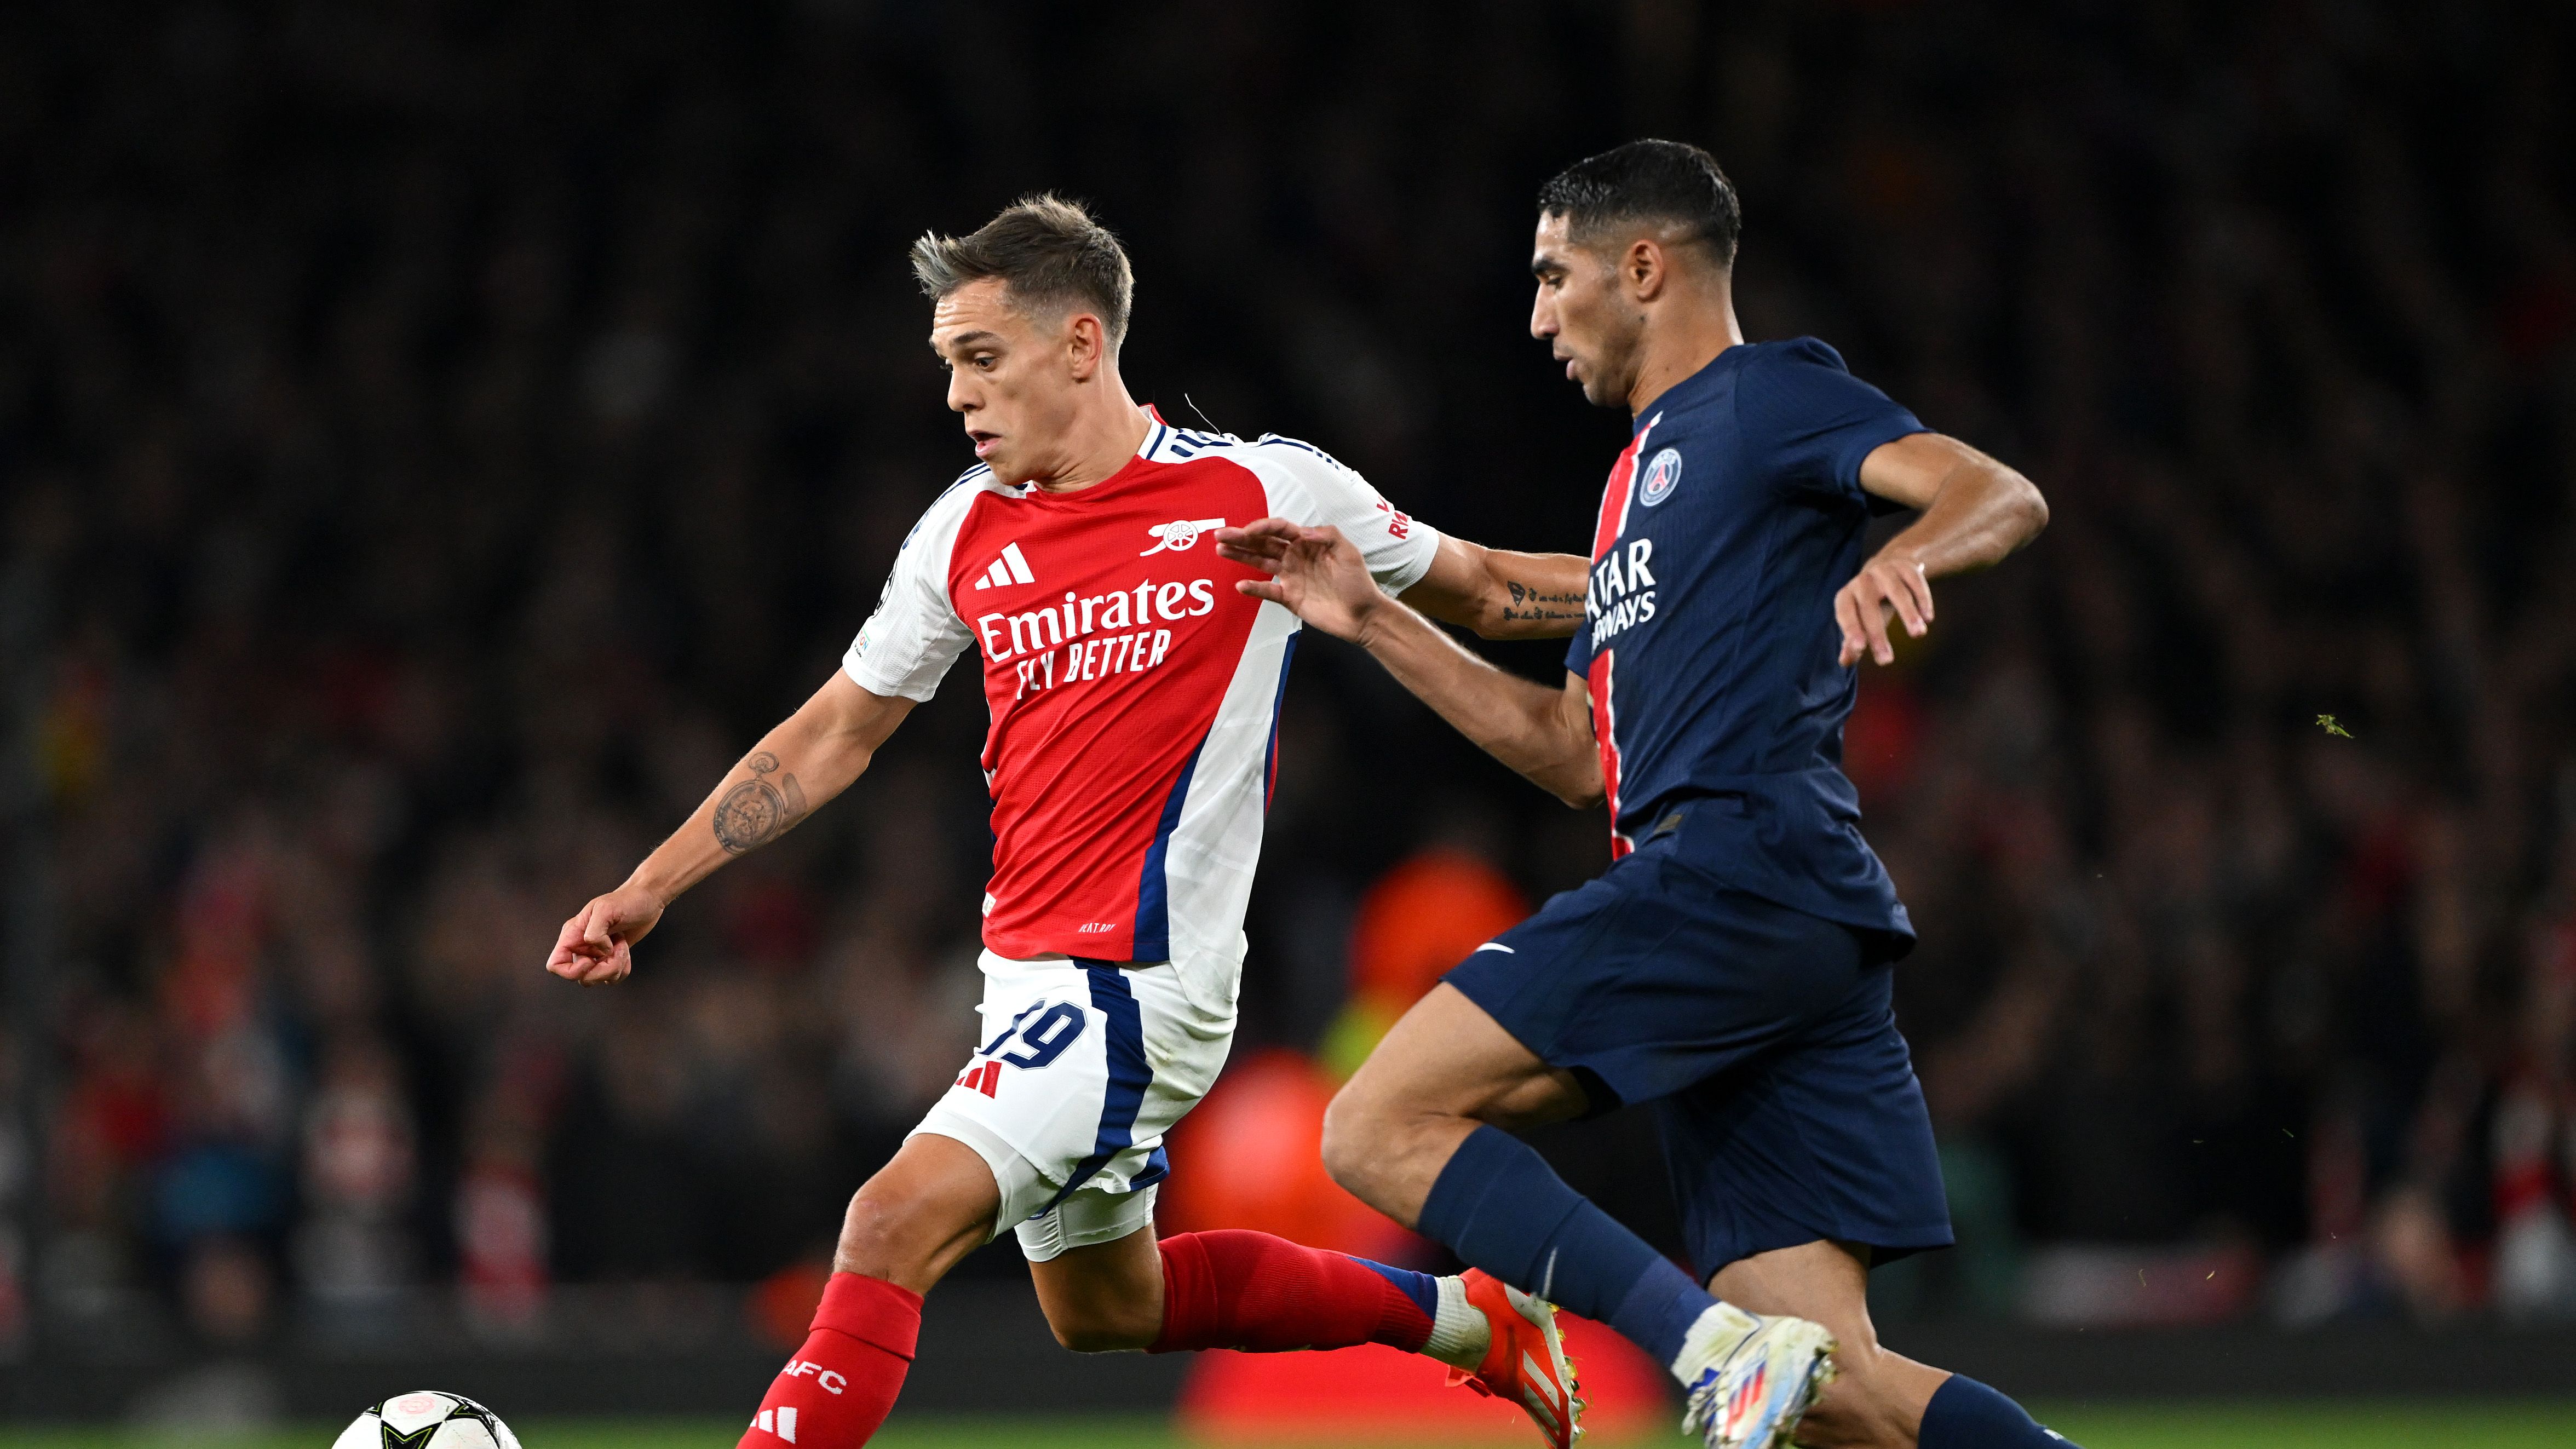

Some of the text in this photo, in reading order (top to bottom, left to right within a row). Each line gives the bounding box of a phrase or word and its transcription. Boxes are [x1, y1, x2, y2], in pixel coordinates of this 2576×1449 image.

[1585, 538, 1657, 623] ATAR
[978, 578, 1214, 663] Emirates
[1016, 629, 1171, 700] FLY BETTER
[781, 1360, 847, 1395] AFC
